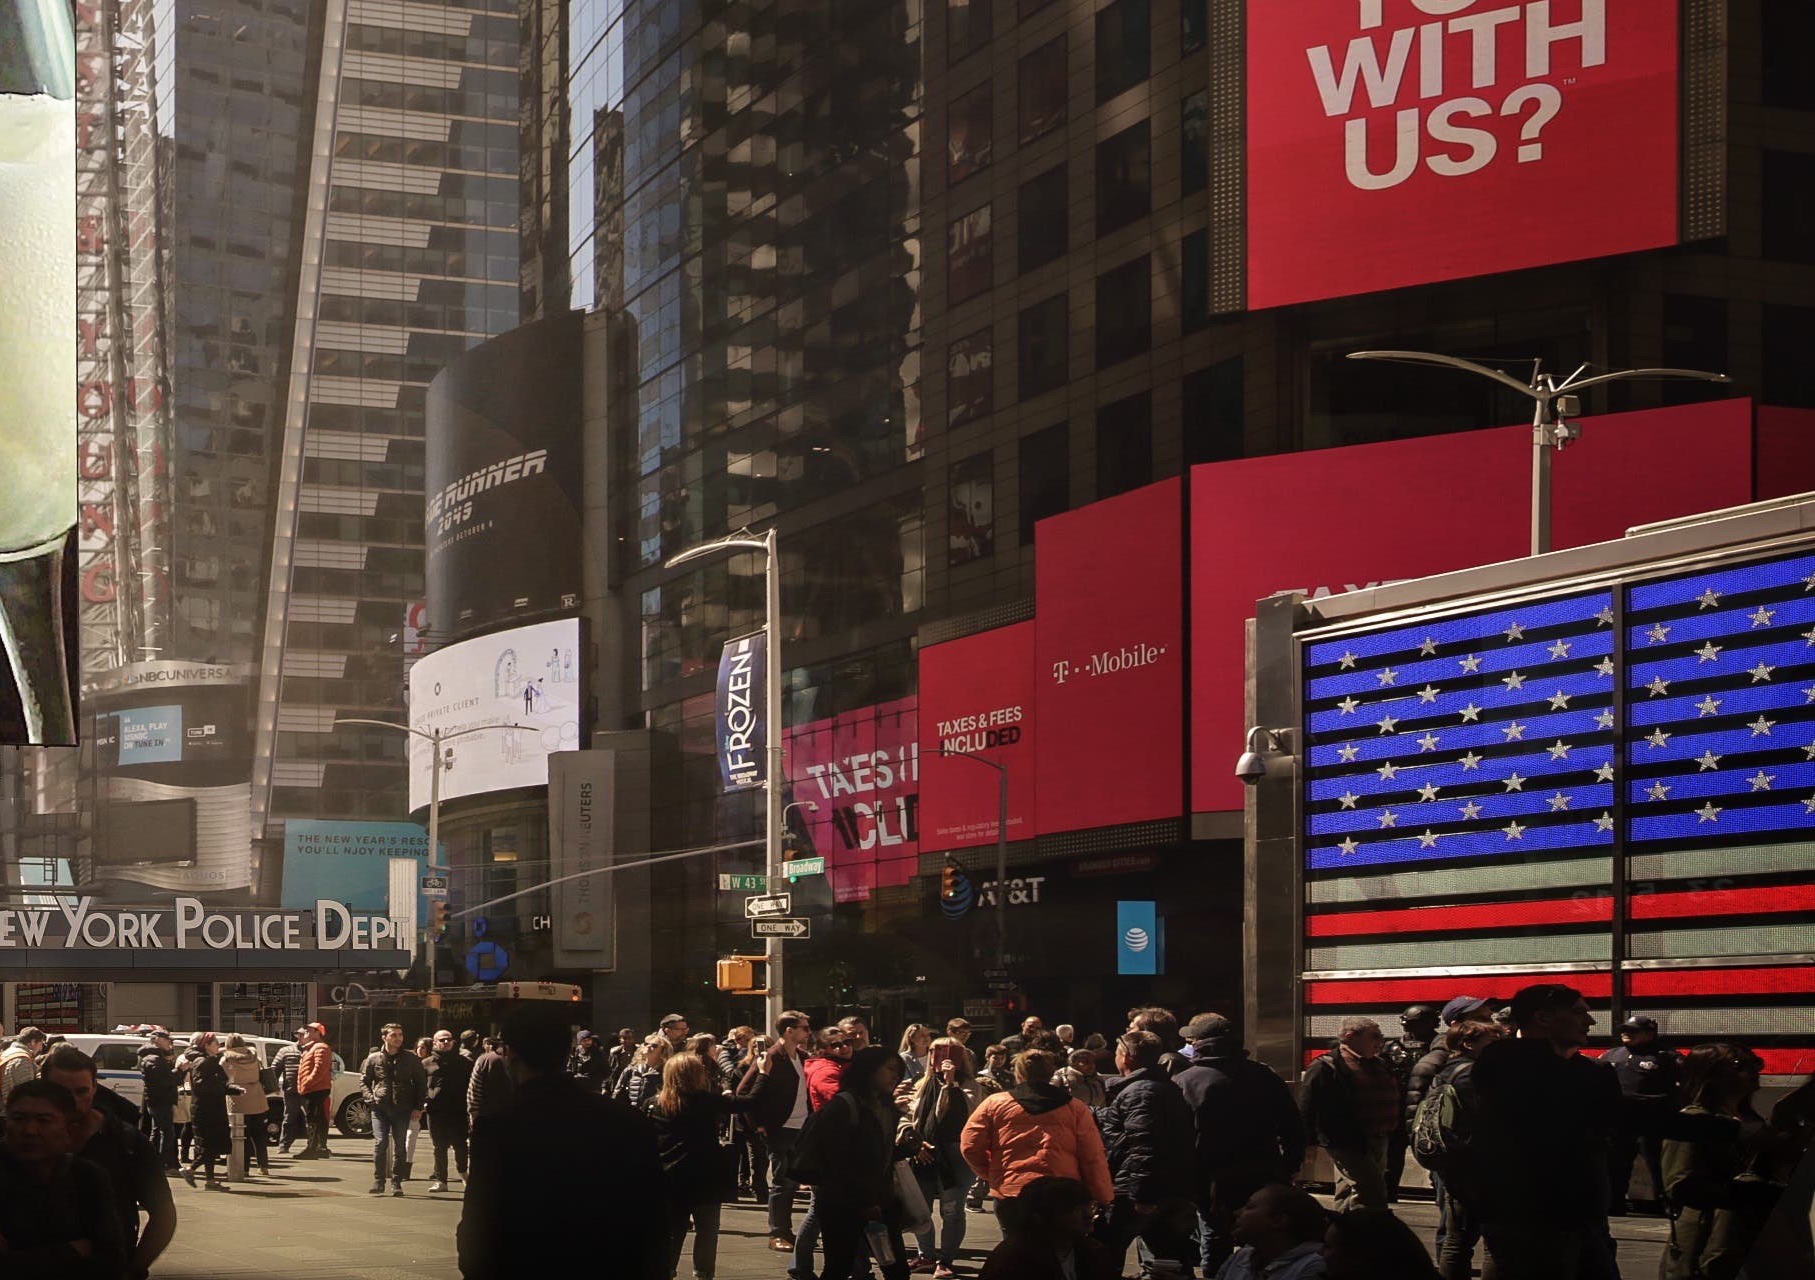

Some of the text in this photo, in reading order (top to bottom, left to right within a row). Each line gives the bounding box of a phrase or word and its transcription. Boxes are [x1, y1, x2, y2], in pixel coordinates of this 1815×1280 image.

[1344, 83, 1563, 191] US?
[444, 449, 548, 509] RUNNER
[437, 501, 473, 537] 2049
[453, 697, 480, 710] CLIENT
[726, 652, 756, 772] FROZEN
[149, 722, 168, 730] PLAY
[937, 706, 1023, 737] TAXES & FEES
[297, 834, 320, 844] THE
[325, 835, 350, 844] NEW
[355, 836, 397, 845] YEAR'S
[297, 845, 340, 855] YOU'LL
[378, 847, 429, 857] KEEPING
[789, 861, 822, 874] Broadway
[732, 879, 741, 889] W
[745, 878, 756, 889] 43
[55, 895, 163, 949] YORK
[174, 897, 300, 950] POLICE
[532, 916, 551, 930] CH
[761, 924, 801, 932] ONE WAY
